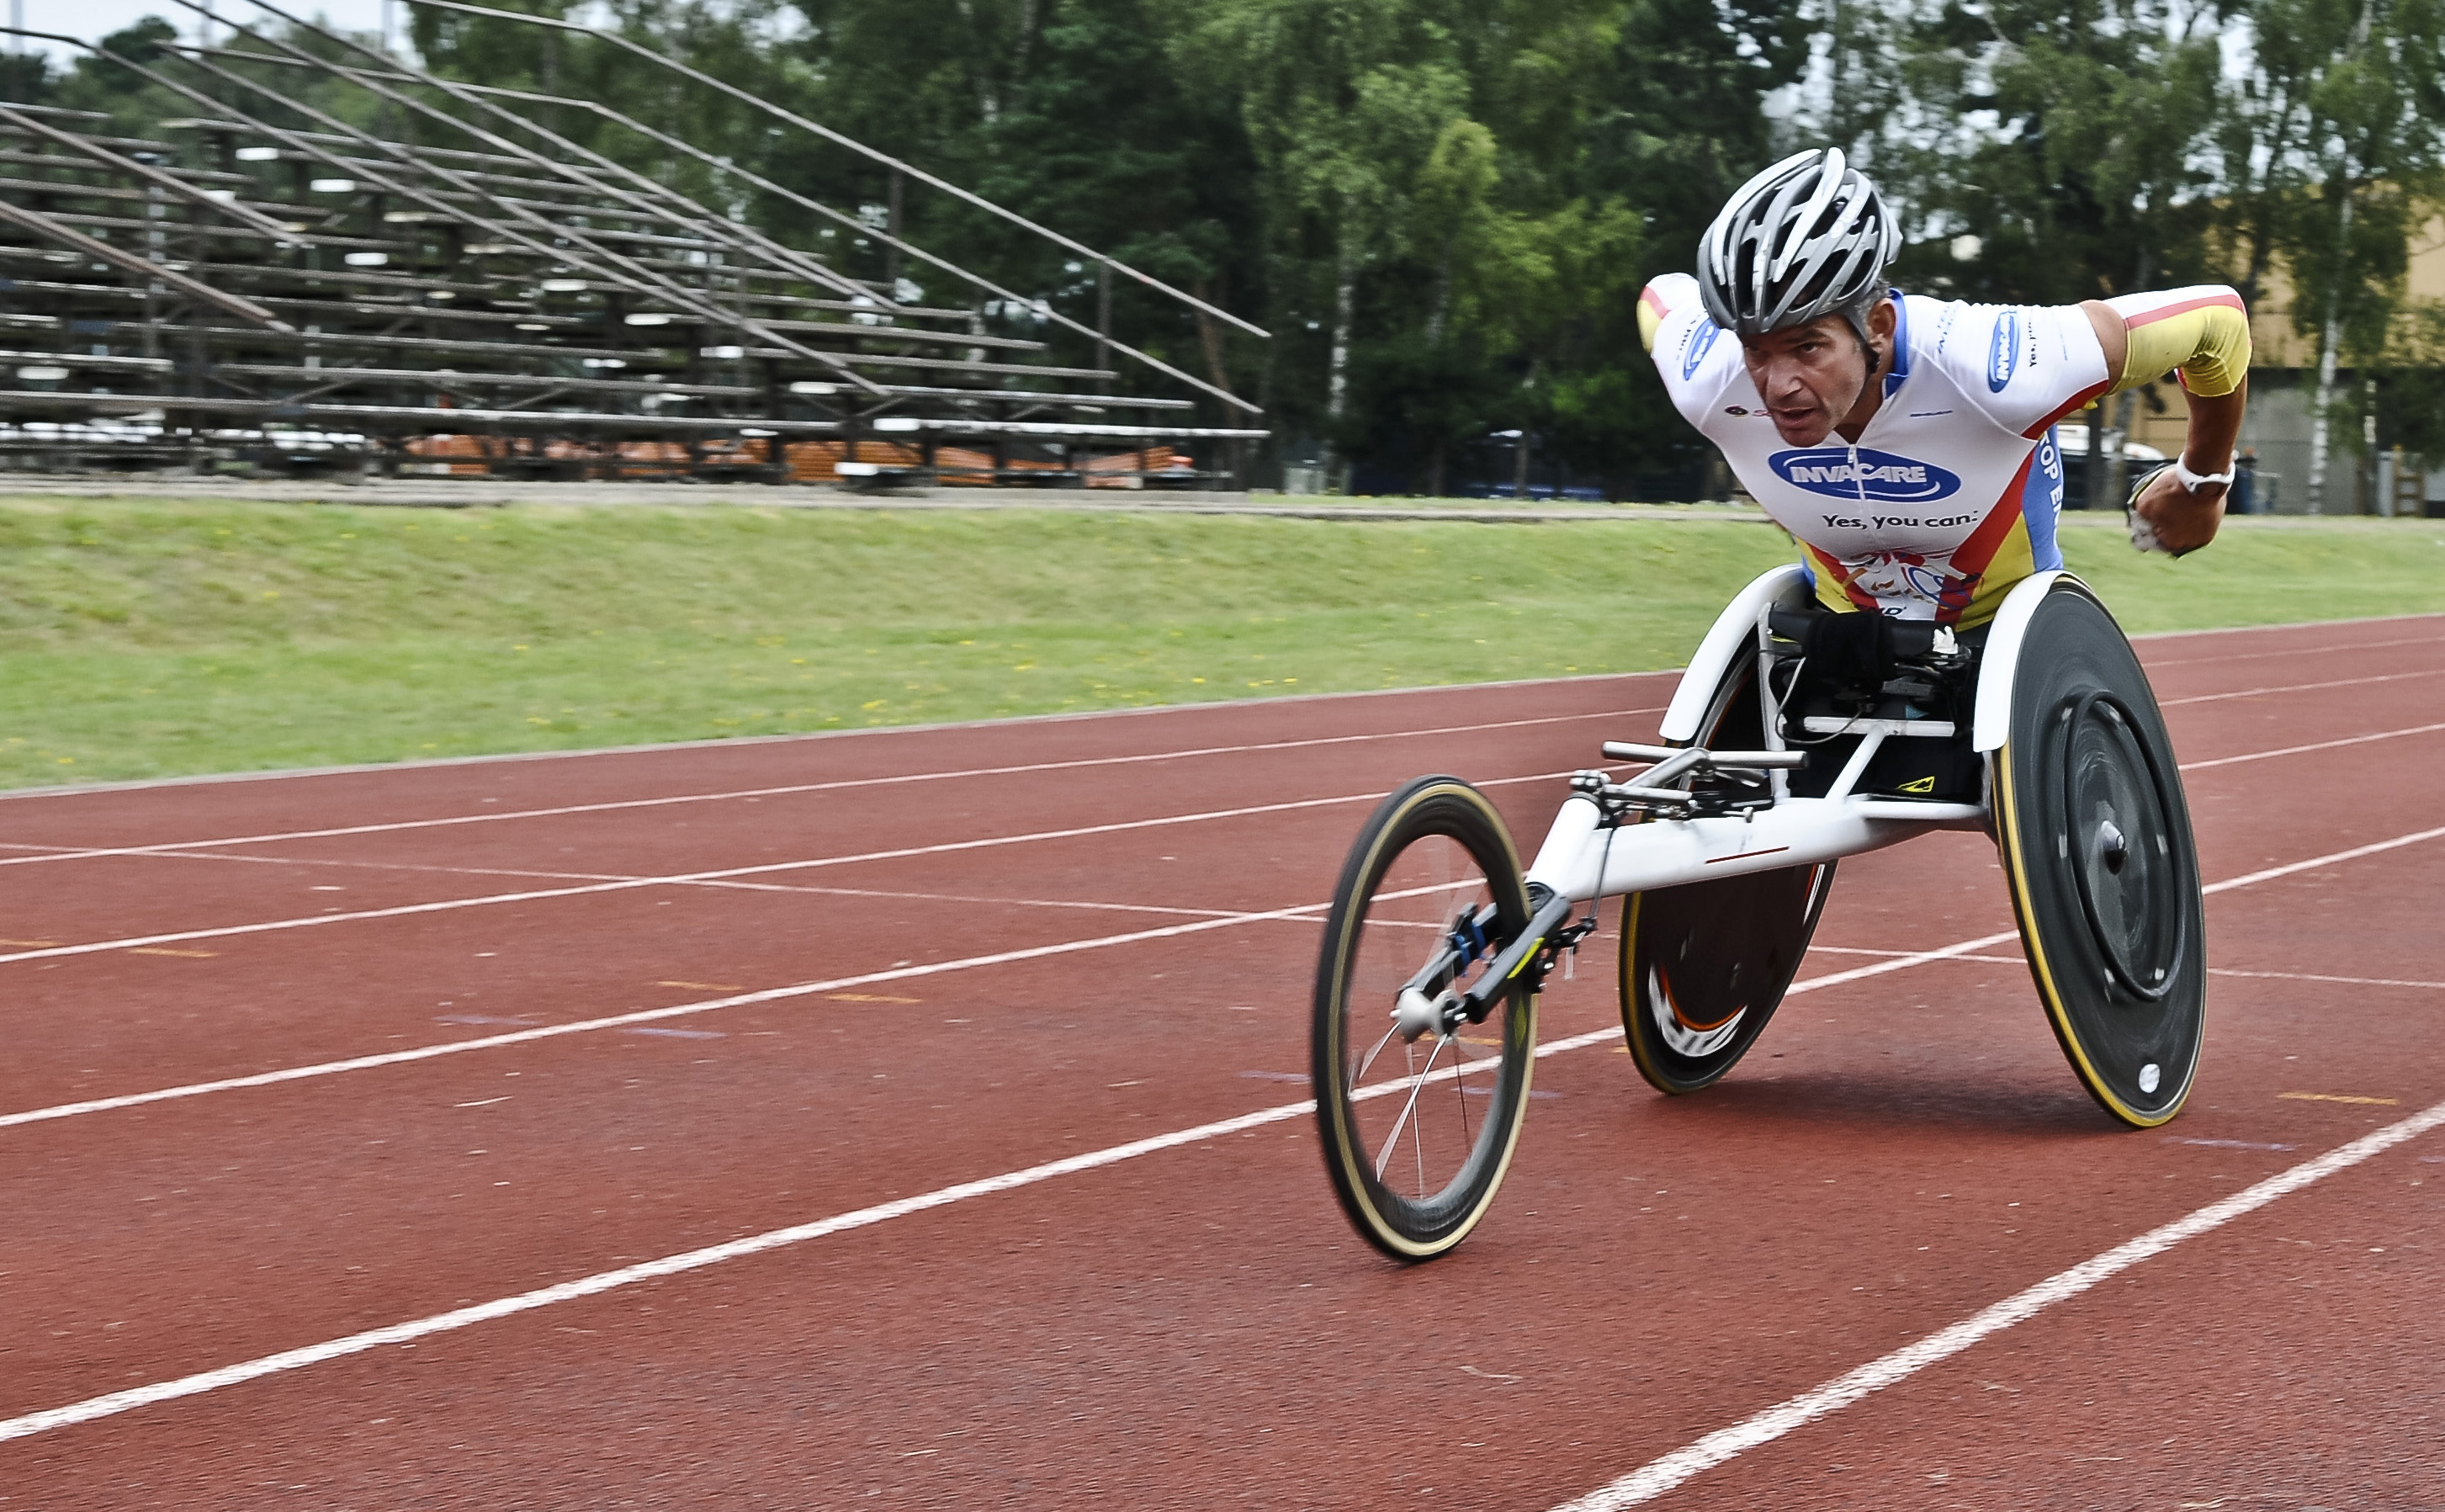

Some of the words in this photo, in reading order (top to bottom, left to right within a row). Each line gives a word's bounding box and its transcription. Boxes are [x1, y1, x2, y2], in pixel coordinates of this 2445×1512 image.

[2039, 430, 2060, 480] TOP
[1789, 463, 1928, 483] INVACARE
[1822, 514, 1868, 530] Yes,
[1870, 516, 1918, 530] you
